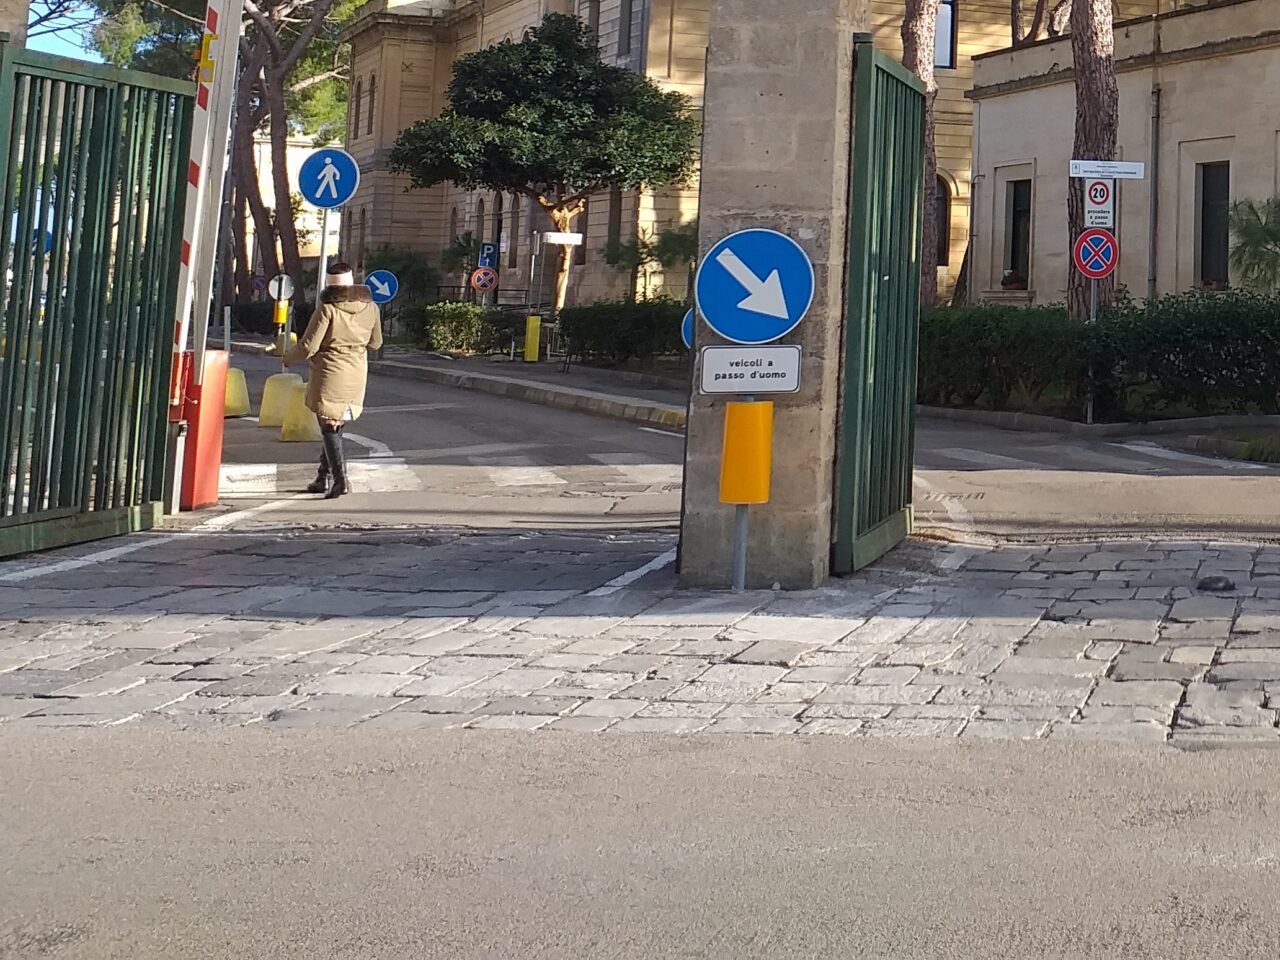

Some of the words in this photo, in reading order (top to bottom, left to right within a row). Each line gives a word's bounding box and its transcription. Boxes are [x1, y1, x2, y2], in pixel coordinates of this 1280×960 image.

[1092, 187, 1106, 199] 20
[483, 245, 494, 257] P
[729, 359, 763, 368] veicoli
[714, 372, 745, 381] passo
[750, 371, 787, 379] d'uomo
